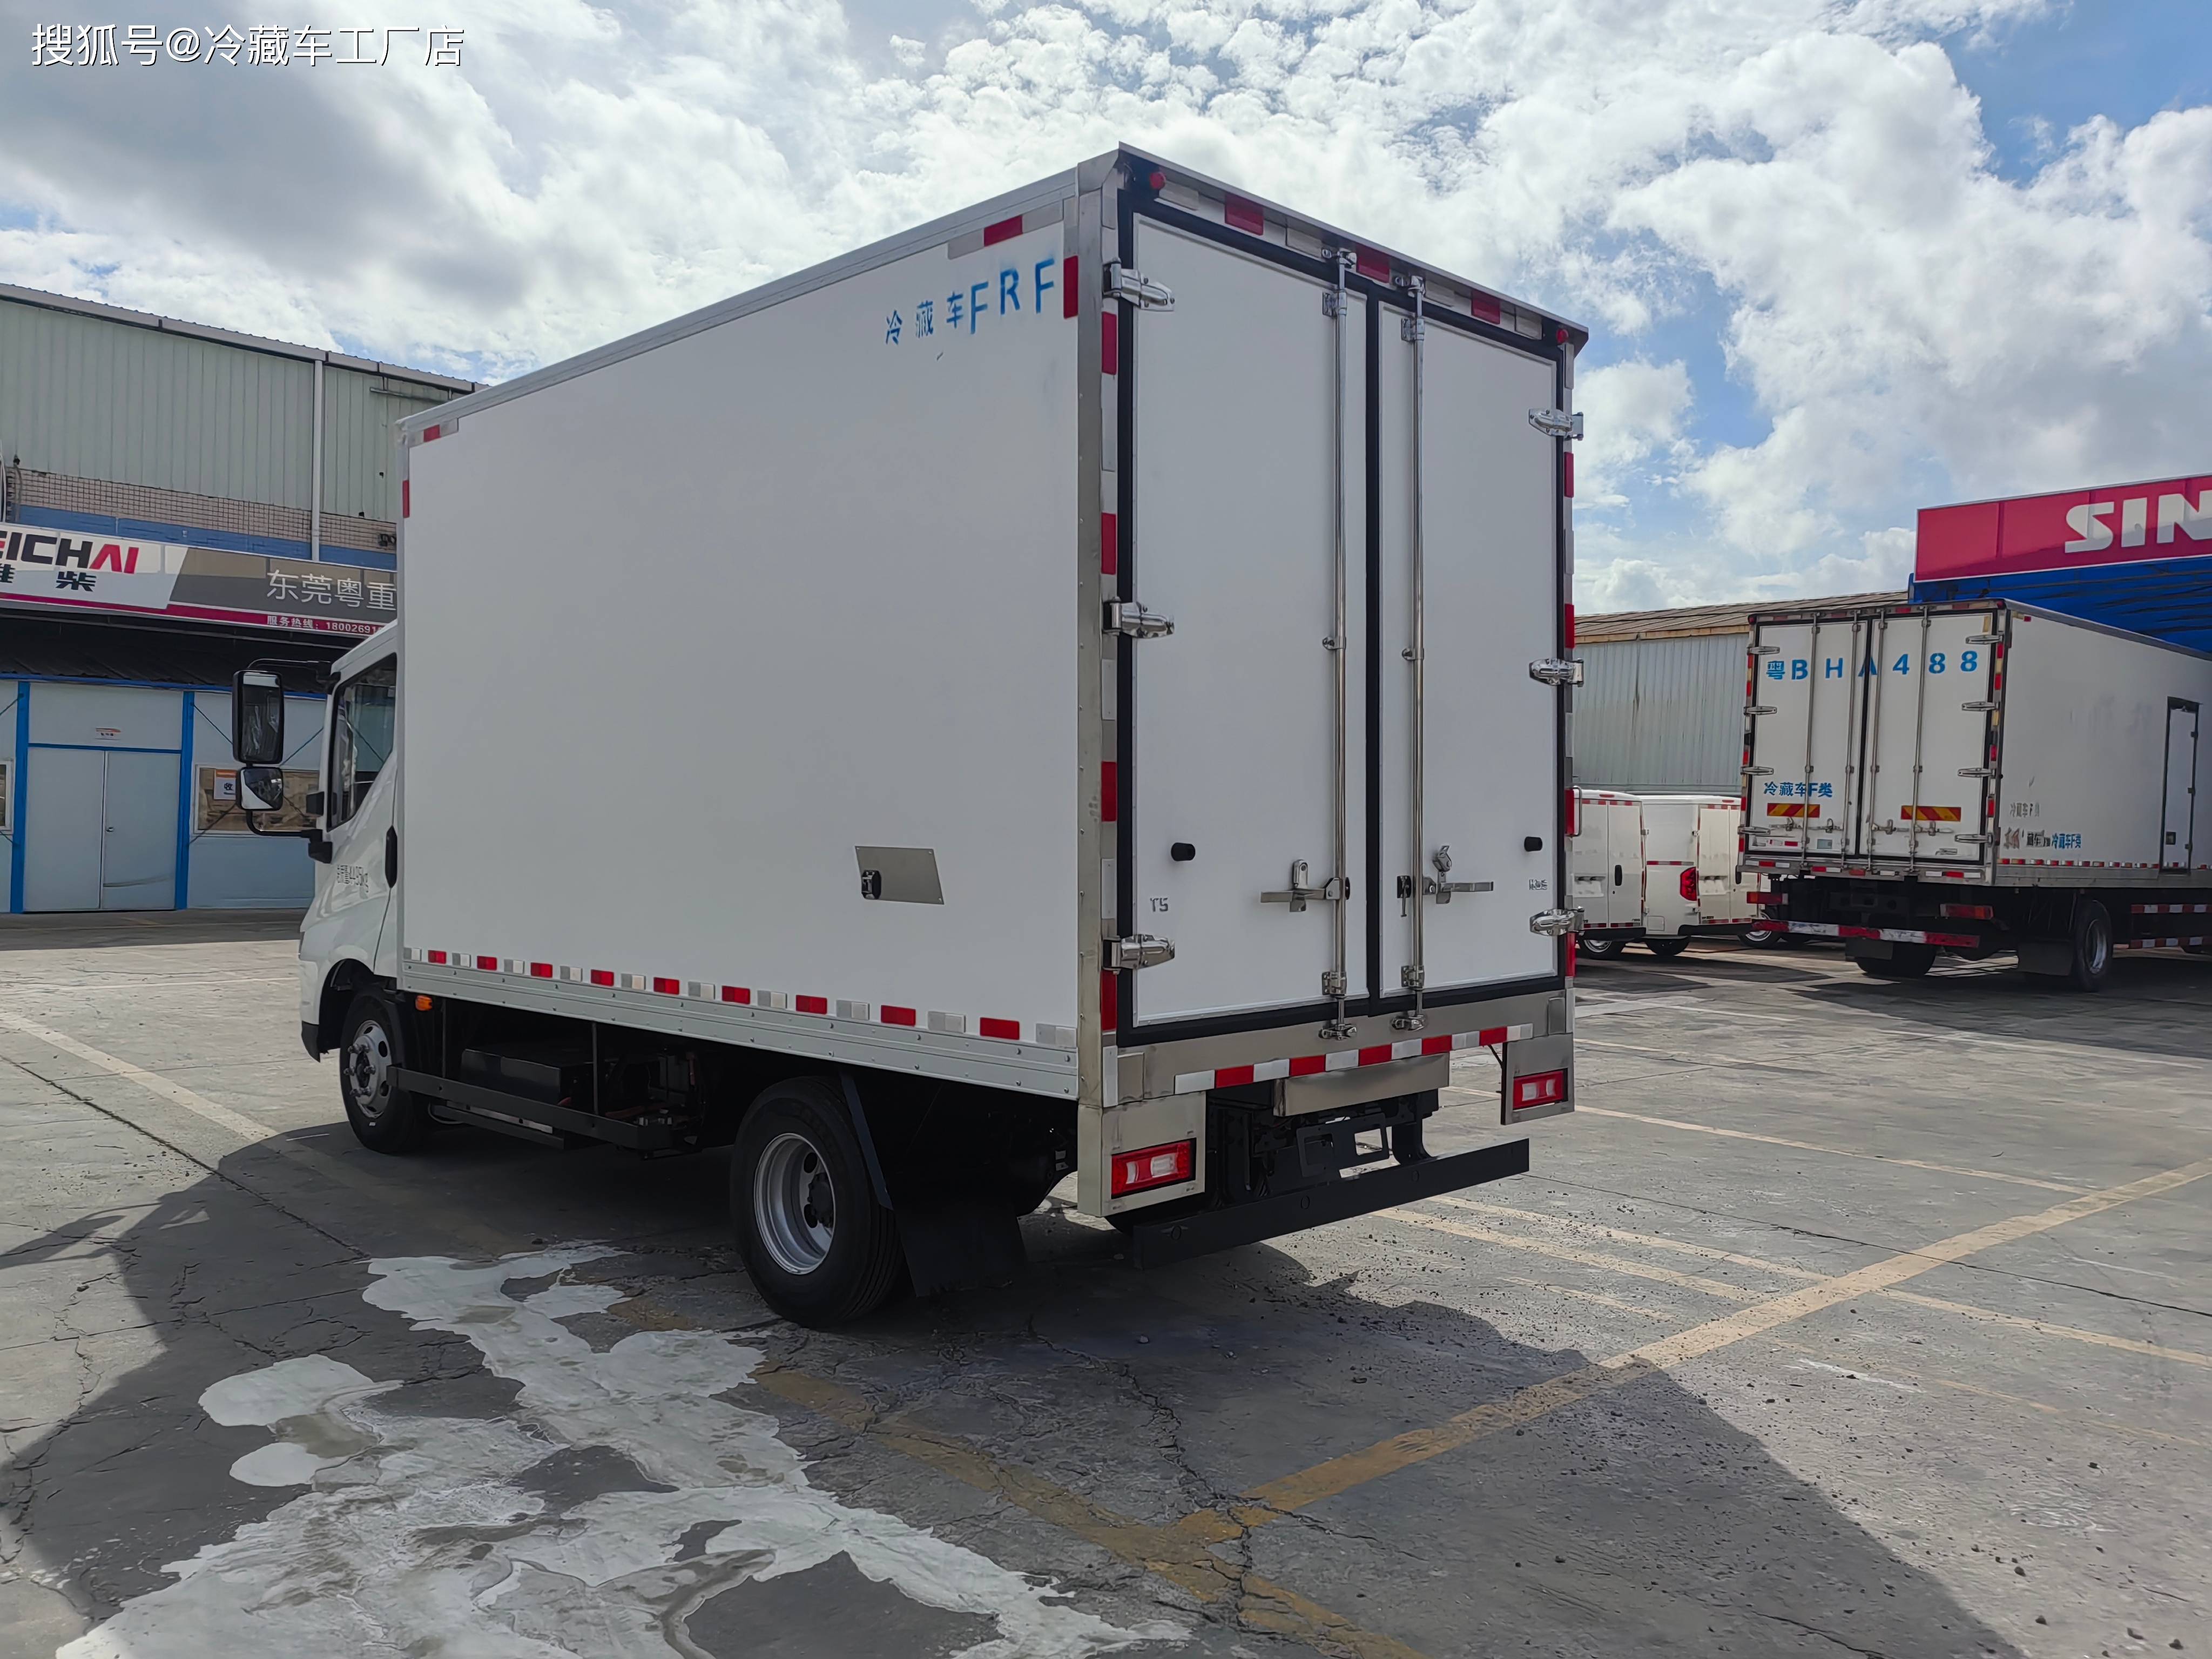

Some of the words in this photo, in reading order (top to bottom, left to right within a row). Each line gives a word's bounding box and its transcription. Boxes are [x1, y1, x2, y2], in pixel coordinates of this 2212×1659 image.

[0, 530, 139, 574] ICHAI
[267, 569, 397, 611] 东莞粤重
